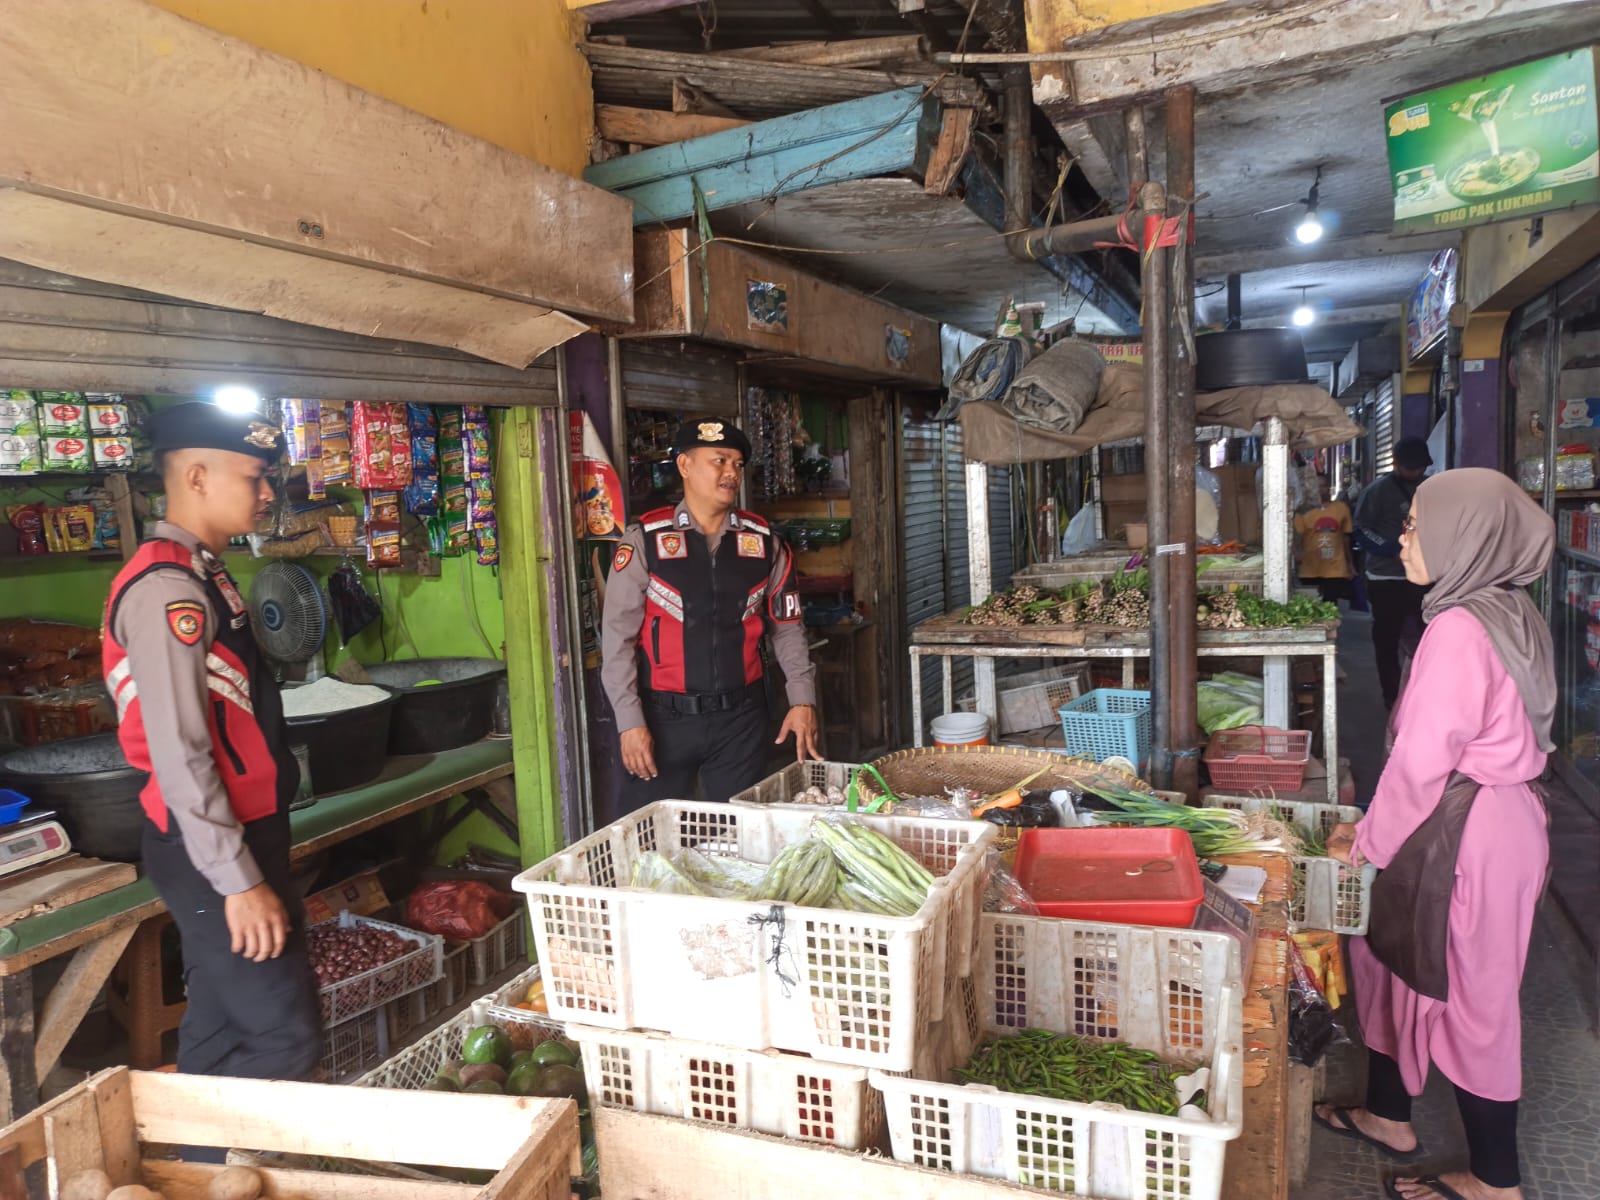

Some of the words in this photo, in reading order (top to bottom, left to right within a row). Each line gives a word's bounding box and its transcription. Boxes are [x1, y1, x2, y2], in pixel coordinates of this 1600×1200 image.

[1434, 207, 1466, 224] TOKO
[1469, 202, 1494, 219] PAK
[1497, 189, 1553, 213] LUKMAN
